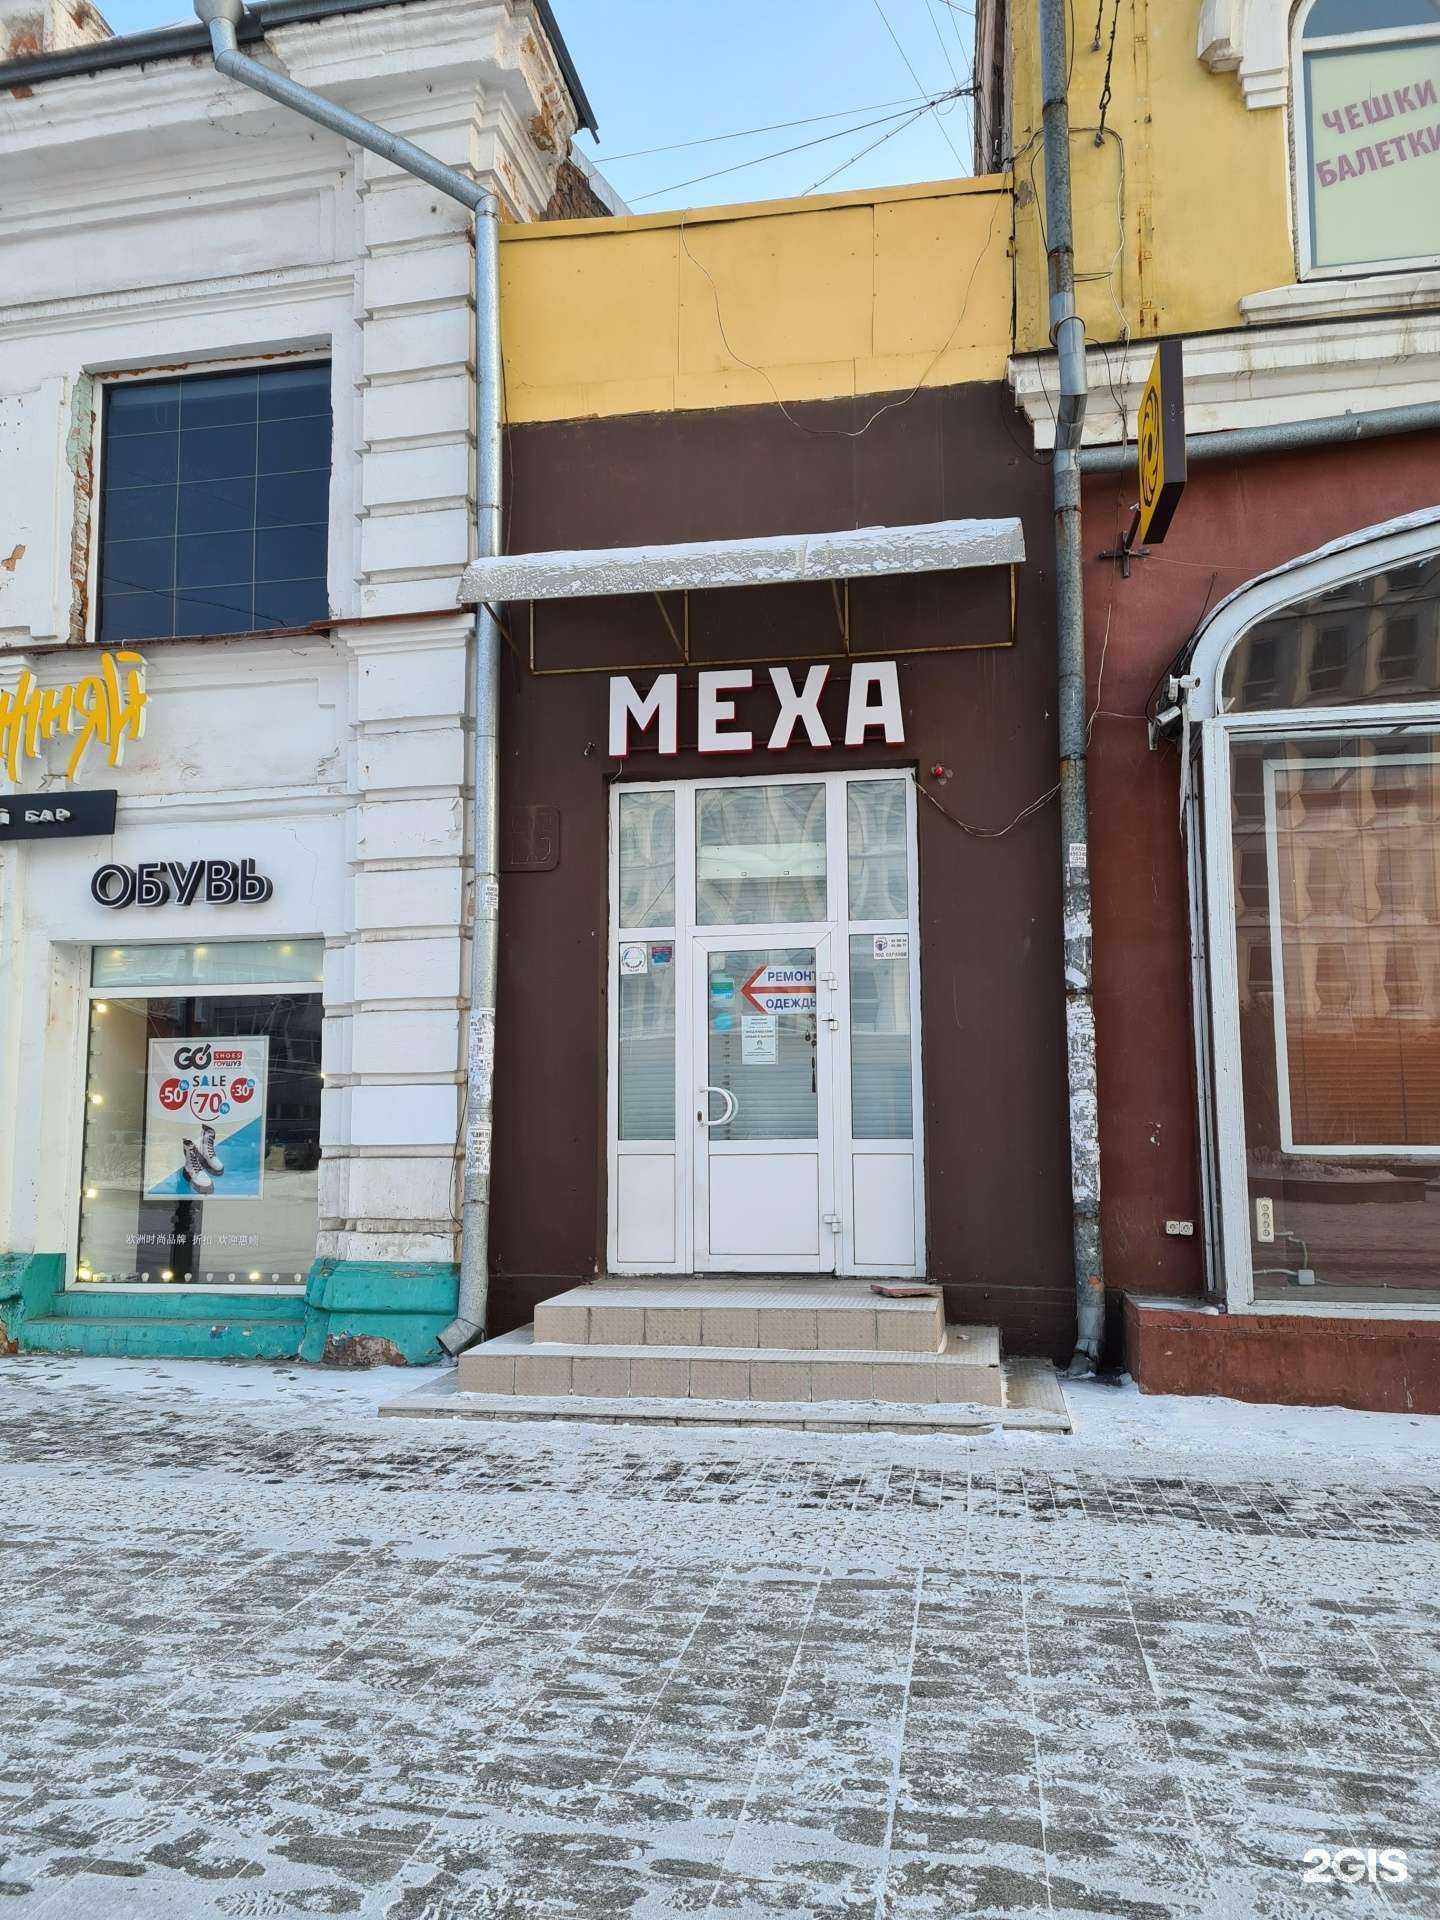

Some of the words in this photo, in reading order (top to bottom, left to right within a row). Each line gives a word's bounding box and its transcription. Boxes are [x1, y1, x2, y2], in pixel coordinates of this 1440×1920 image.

[1322, 79, 1438, 134] ЧЕШКИ
[608, 660, 906, 759] МЕХА
[24, 808, 71, 824] БАР
[91, 857, 273, 909] ОБУВЬ
[214, 1051, 242, 1060] SHOES
